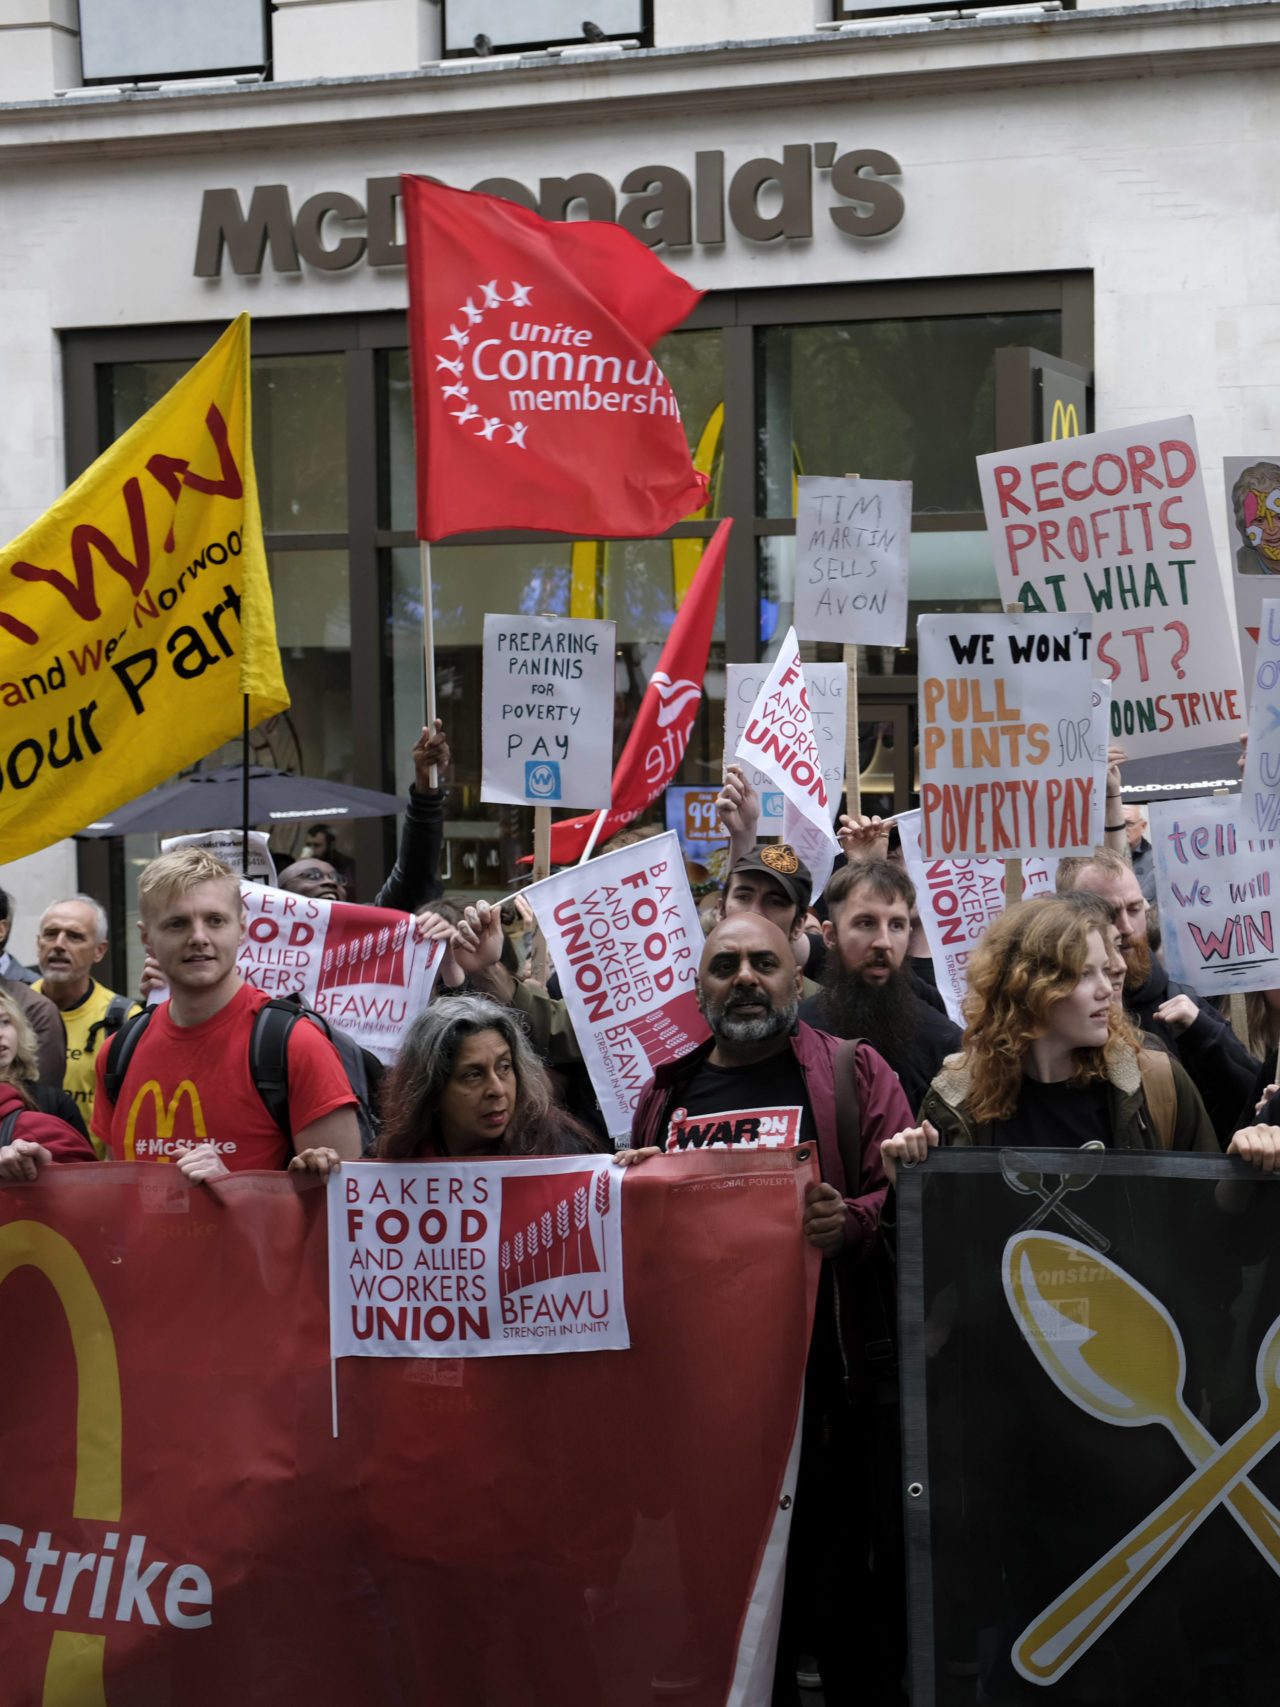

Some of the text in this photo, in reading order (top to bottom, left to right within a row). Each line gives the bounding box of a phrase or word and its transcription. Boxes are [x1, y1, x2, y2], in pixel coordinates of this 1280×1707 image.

[508, 319, 593, 349] unite
[993, 440, 1197, 518] RECORD
[810, 494, 882, 528] TIM
[808, 527, 896, 552] MARTIN
[1005, 496, 1192, 576] PROFITS
[809, 557, 878, 584] SELLS
[1018, 560, 1196, 613] AT WHAT
[814, 587, 888, 617] AVON
[498, 632, 599, 655] PREPARING
[949, 627, 1092, 664] WE WON'T
[1096, 620, 1190, 683] ST?
[0, 656, 66, 707] and
[509, 657, 583, 680] PANINIS
[531, 683, 554, 696] FOR
[769, 691, 807, 723] AND
[924, 677, 1021, 724] PULL
[502, 703, 581, 725] POVERTY
[1110, 690, 1241, 738] OONSTRIKE
[0, 700, 103, 793] our
[507, 734, 568, 760] PAY
[762, 702, 820, 770] WORK
[924, 723, 1050, 770] PINTS
[744, 718, 828, 808] UNION
[922, 779, 1039, 858] POVERTY
[1046, 776, 1094, 849] PAY
[1168, 821, 1237, 864] tell
[922, 859, 967, 946] NION
[1230, 871, 1271, 904] will
[241, 892, 320, 919] KERS
[650, 861, 697, 983] BAKERS
[250, 917, 315, 947] OD
[601, 886, 654, 1003] AND ALLIED
[621, 870, 674, 993] FOOD
[239, 945, 311, 968] ALLIED
[553, 897, 614, 1023] UNION
[581, 889, 636, 1012] WORKERS
[236, 965, 306, 993] KERS
[313, 993, 408, 1023] BFAWU
[593, 1031, 615, 1077] STRENGTH
[615, 1089, 630, 1115] UNITY
[677, 1118, 761, 1150] WAR
[759, 1116, 788, 1134] ON
[346, 1177, 489, 1204] BAKERS
[347, 1208, 488, 1244] FOOD
[349, 1248, 486, 1270] AND ALLIED
[350, 1274, 487, 1302] WORKERS
[351, 1305, 490, 1341] UNION
[501, 1289, 609, 1324] BFAWU
[503, 1320, 610, 1339] STRENGTH IN UNITY
